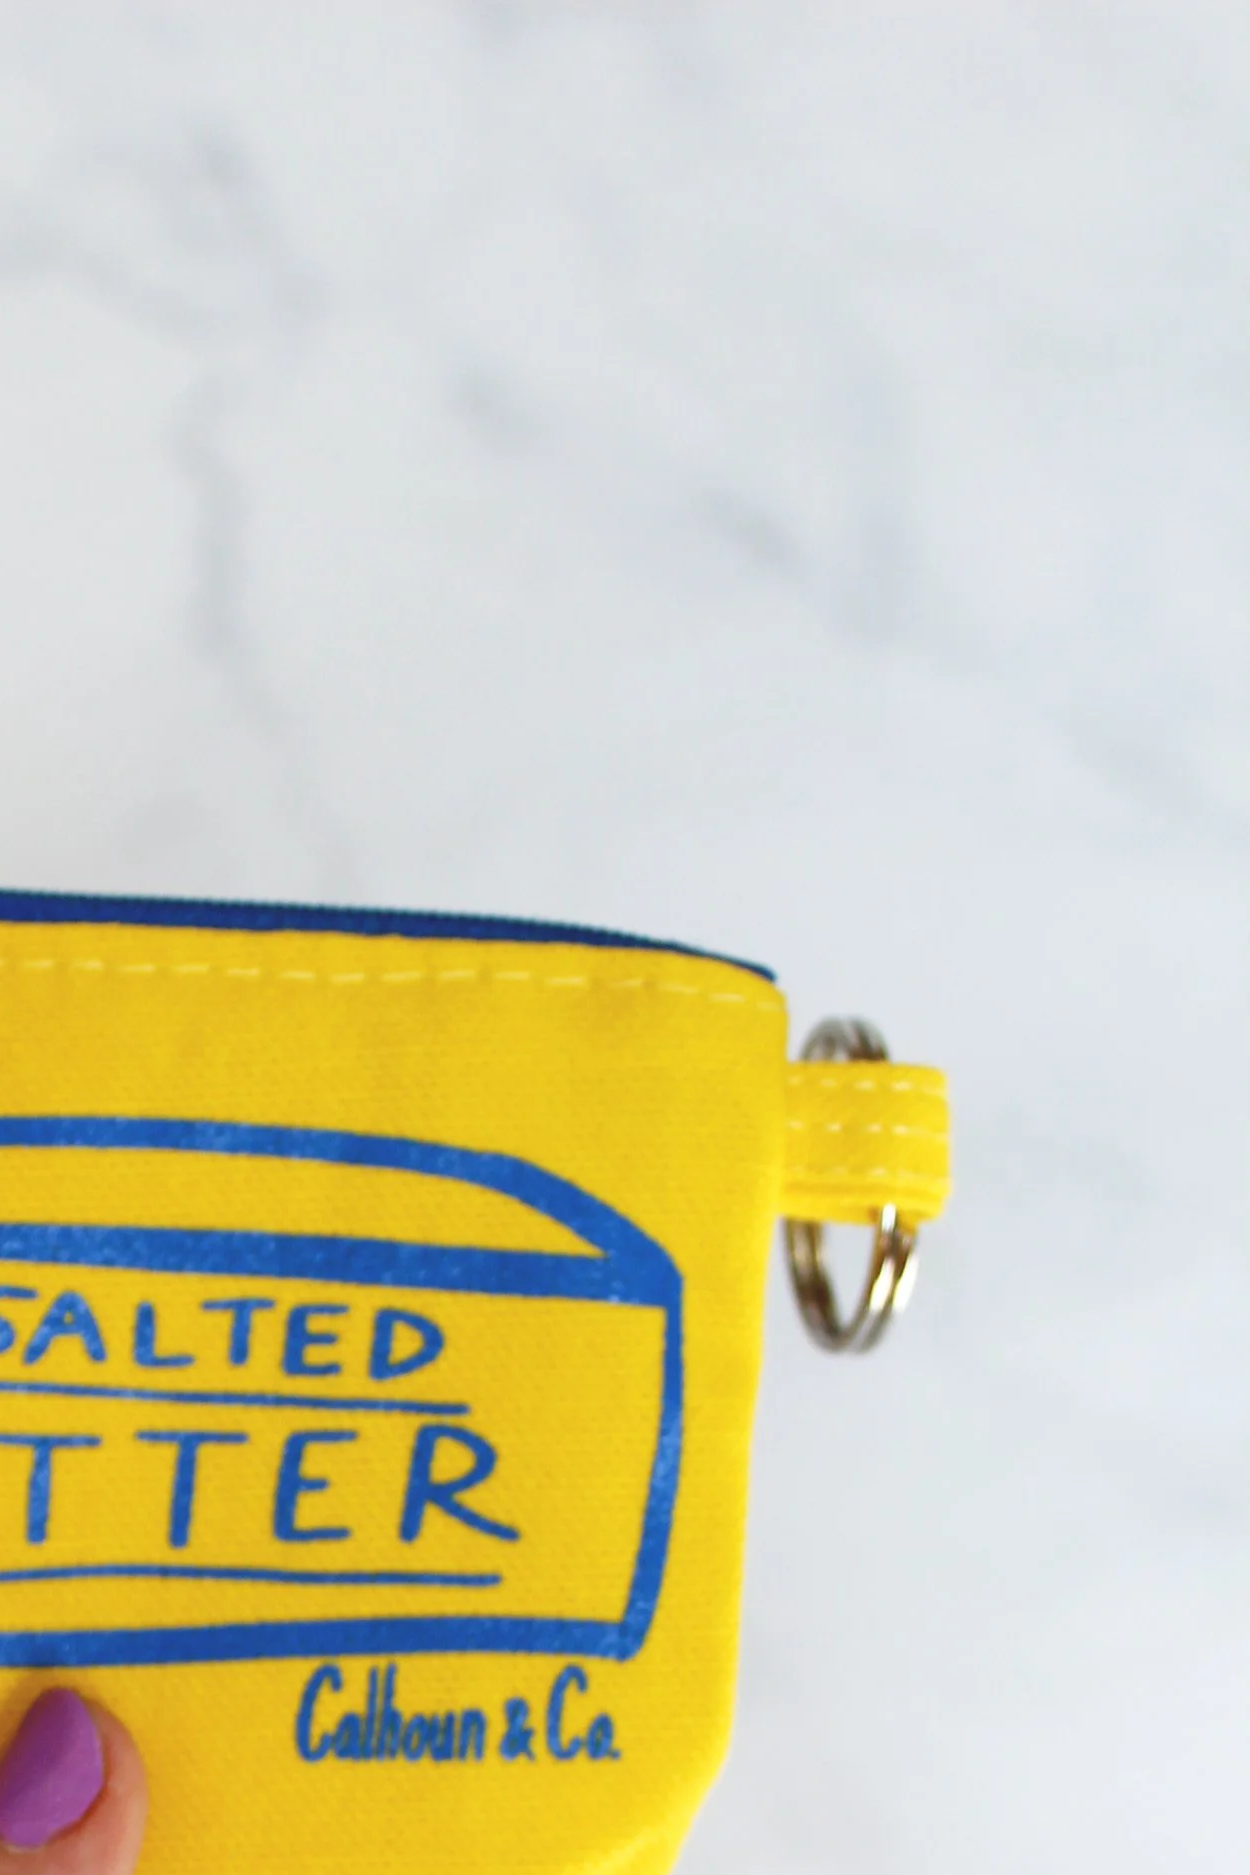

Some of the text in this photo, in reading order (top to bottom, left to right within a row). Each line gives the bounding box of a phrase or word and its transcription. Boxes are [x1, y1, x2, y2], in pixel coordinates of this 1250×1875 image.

[296, 1664, 621, 1762] Calhoun & Co.
